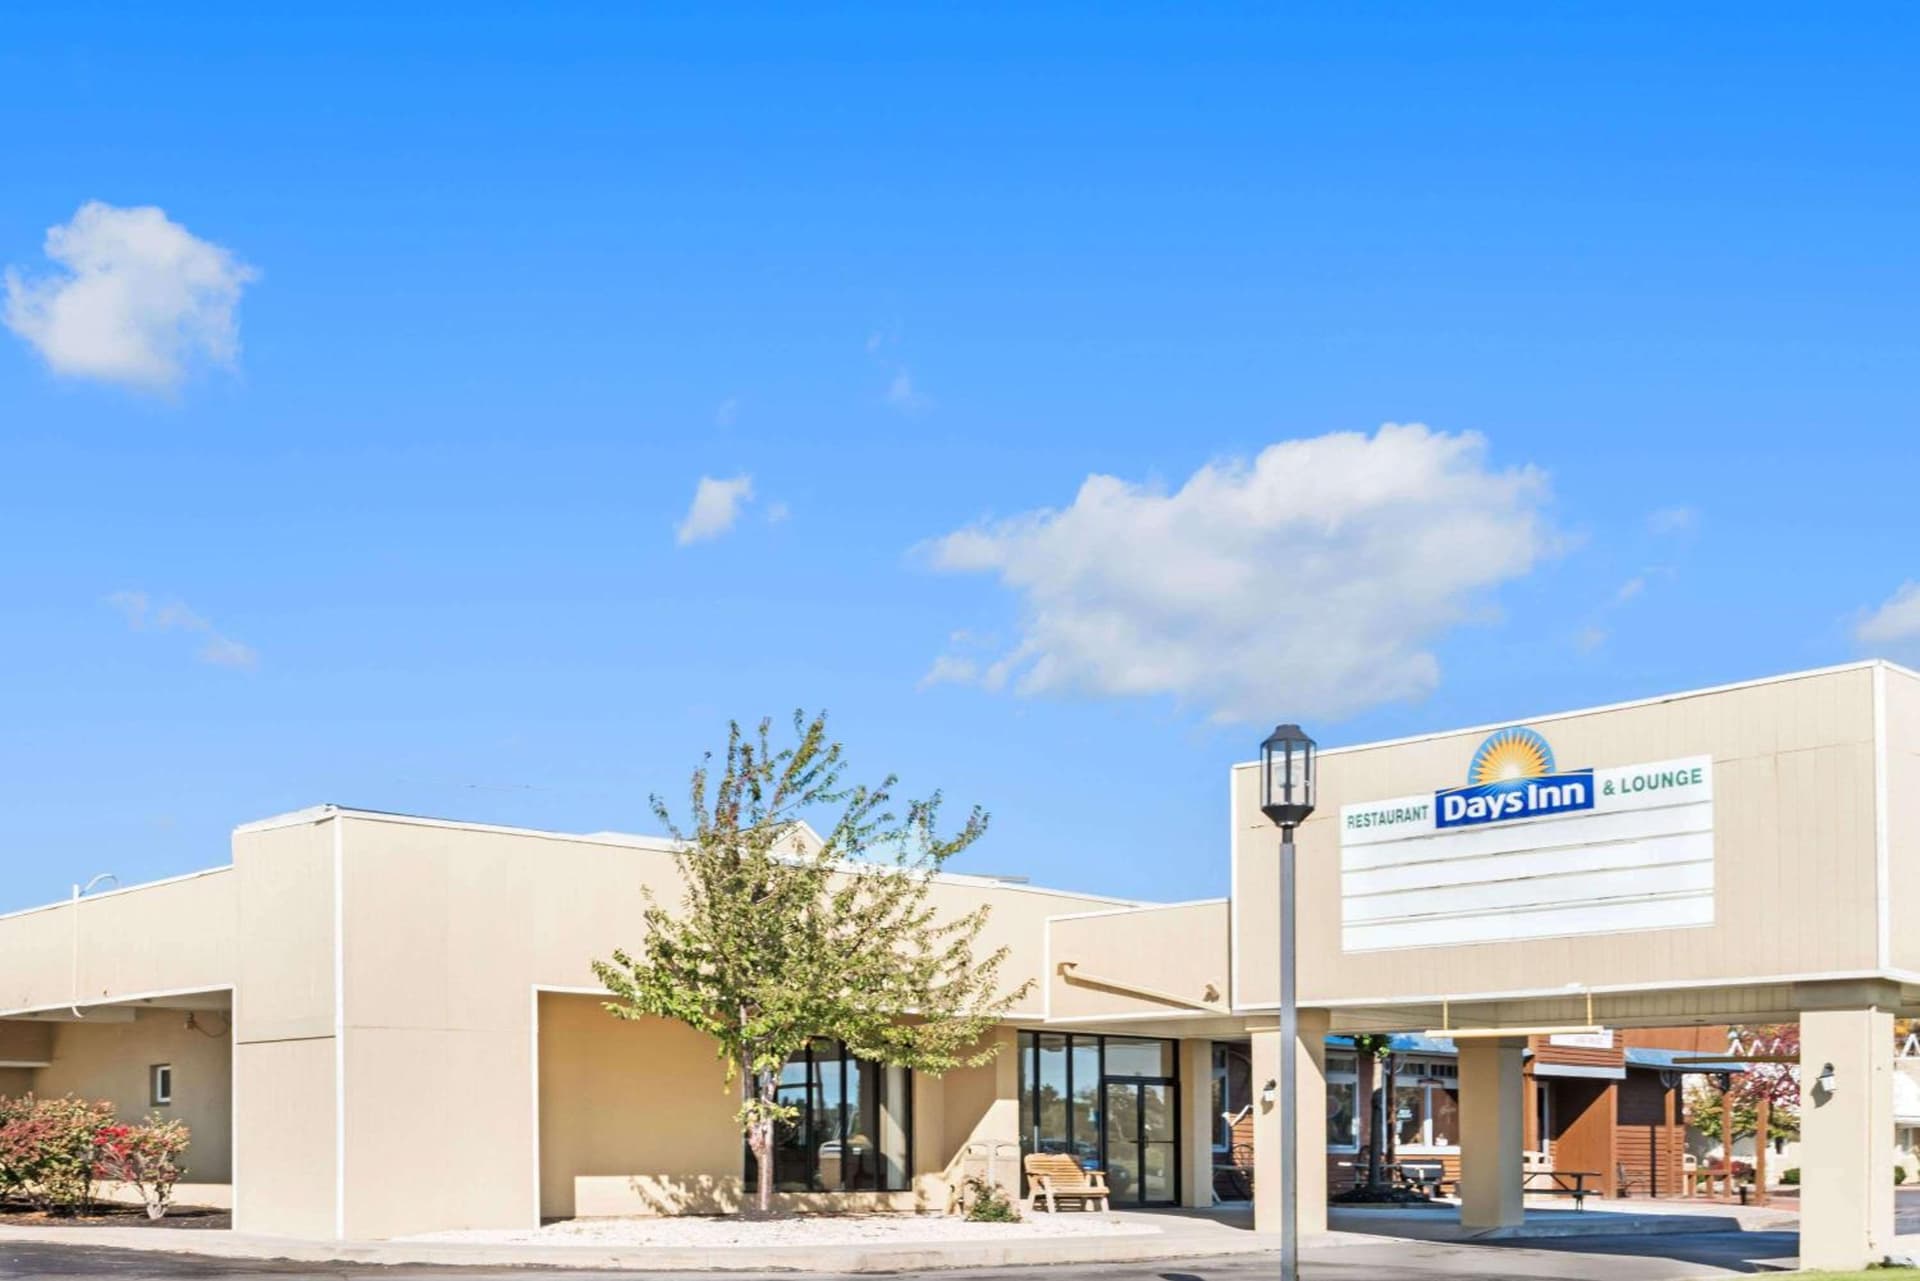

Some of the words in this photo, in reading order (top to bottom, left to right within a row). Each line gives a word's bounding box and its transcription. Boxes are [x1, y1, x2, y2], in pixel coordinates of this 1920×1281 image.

[1602, 779, 1615, 796] &
[1621, 768, 1703, 793] LOUNGE
[1444, 790, 1523, 819] Days
[1528, 782, 1585, 810] Inn
[1347, 805, 1428, 829] RESTAURANT
